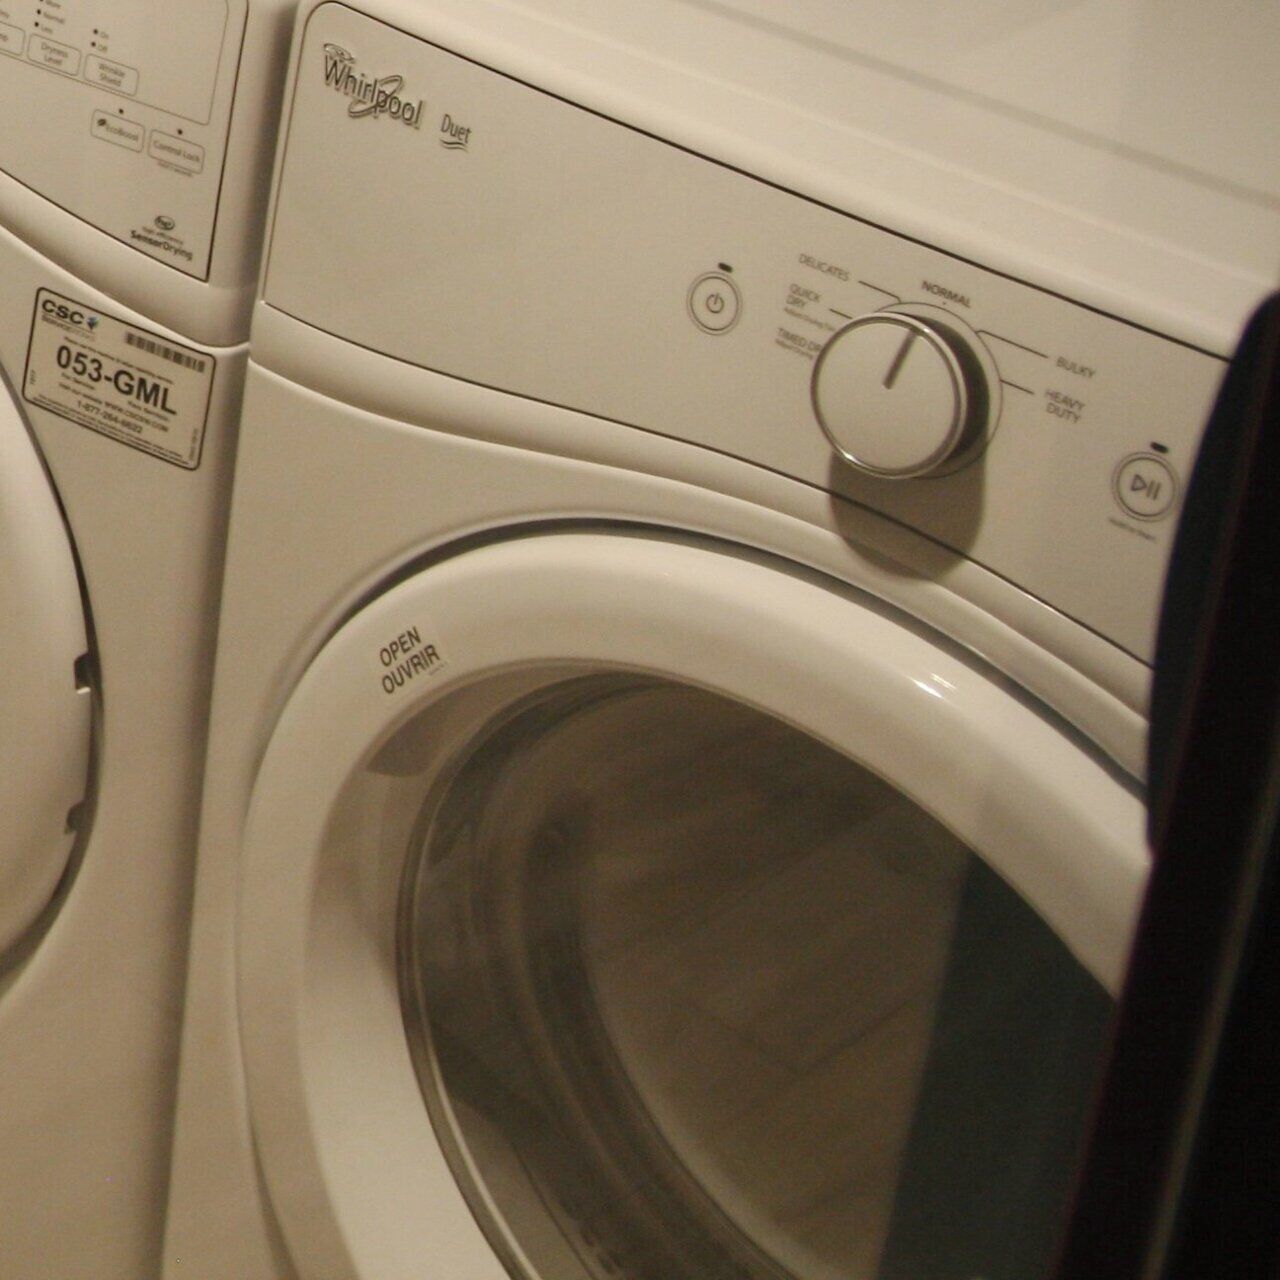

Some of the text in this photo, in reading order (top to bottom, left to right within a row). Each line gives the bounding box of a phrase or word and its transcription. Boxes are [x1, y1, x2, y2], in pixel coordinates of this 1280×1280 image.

[324, 54, 472, 144] Whirlpool Duet
[130, 230, 193, 262] SensorDrying
[798, 253, 850, 282] DELICATES
[786, 294, 807, 309] DRY
[789, 283, 821, 303] QUICK
[921, 280, 972, 309] NORMAL
[42, 299, 85, 325] CSC
[777, 327, 807, 348] TIMED
[56, 345, 177, 416] 053-GML
[1056, 356, 1096, 379] BULKY
[1045, 388, 1086, 410] HEAVY
[1046, 402, 1081, 423] DUTY
[380, 625, 421, 667] OPEN
[382, 644, 440, 694] OUVRIR
